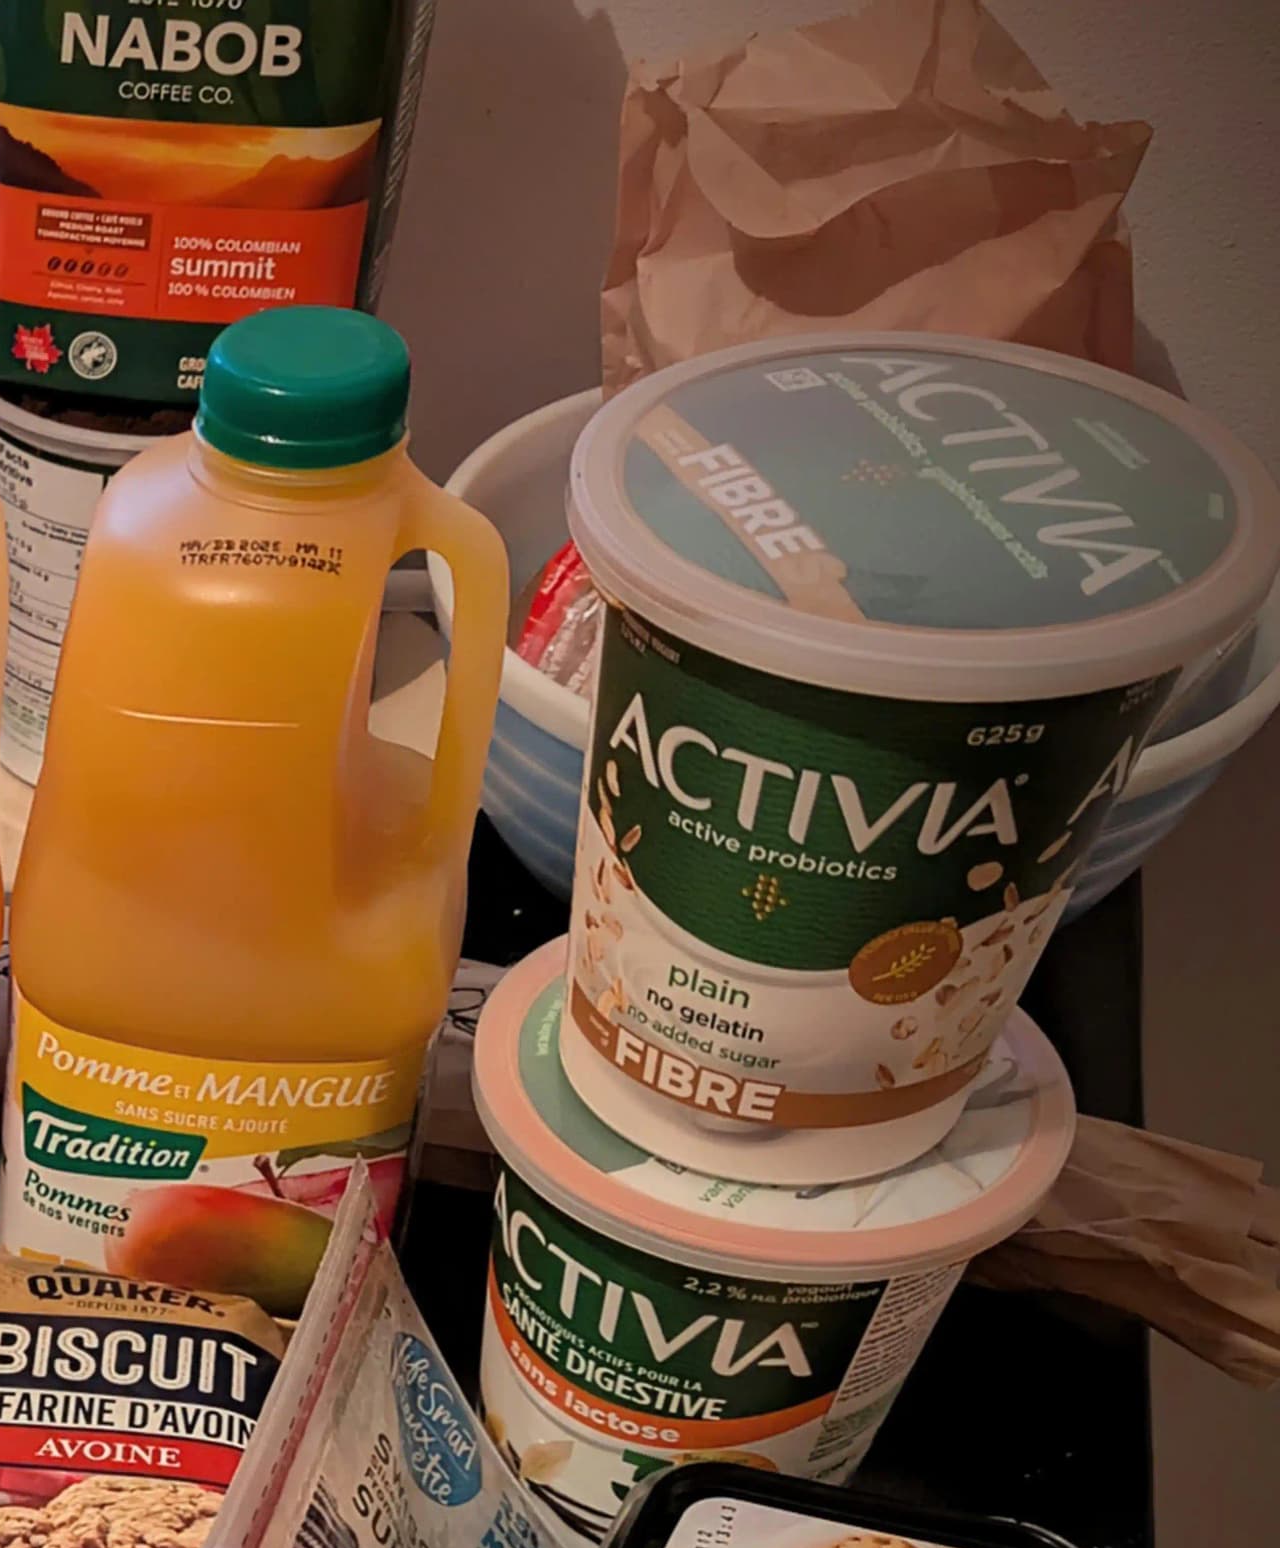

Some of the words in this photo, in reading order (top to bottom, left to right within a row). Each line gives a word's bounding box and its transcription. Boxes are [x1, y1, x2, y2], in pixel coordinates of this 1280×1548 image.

[60, 11, 303, 78] NABOB
[119, 81, 191, 103] COFFEE
[199, 84, 234, 105] CO.
[170, 256, 276, 280] summit
[173, 237, 213, 250] 100%
[215, 239, 301, 254] COLOMBIAN
[211, 285, 295, 300] COLOMBIEN
[679, 442, 825, 561] FIBRE
[841, 356, 1163, 596] ACTIVIA
[610, 692, 1019, 857] ACTIVIA
[667, 809, 741, 853] active
[748, 840, 898, 882] probiotics
[668, 961, 751, 1009] plain
[626, 1004, 650, 1026] no
[652, 1012, 713, 1055] added
[719, 1039, 781, 1073] sugar
[645, 985, 675, 1012] no
[679, 1000, 765, 1044] gelatin
[36, 1031, 173, 1097] Pomme
[196, 1069, 396, 1108] MANGUE
[613, 1023, 785, 1122] FIBRE
[26, 1111, 192, 1168] Tradition
[115, 1099, 160, 1122] SANS
[163, 1109, 218, 1131] SUCRE
[223, 1116, 289, 1136] AJOUTÉ
[24, 1167, 132, 1224] Pommes
[67, 1208, 126, 1239] vergers
[27, 1274, 216, 1316] QUAKER
[502, 1283, 563, 1362] SANTÉ
[565, 1350, 727, 1421] DIGESTIVE
[638, 1363, 679, 1388] POUR
[684, 1378, 702, 1392] LA
[508, 1340, 559, 1398] sans
[564, 1390, 681, 1445] lactose
[34, 1437, 182, 1469] AVOINE
[128, 1404, 256, 1448] D'AVOIN
